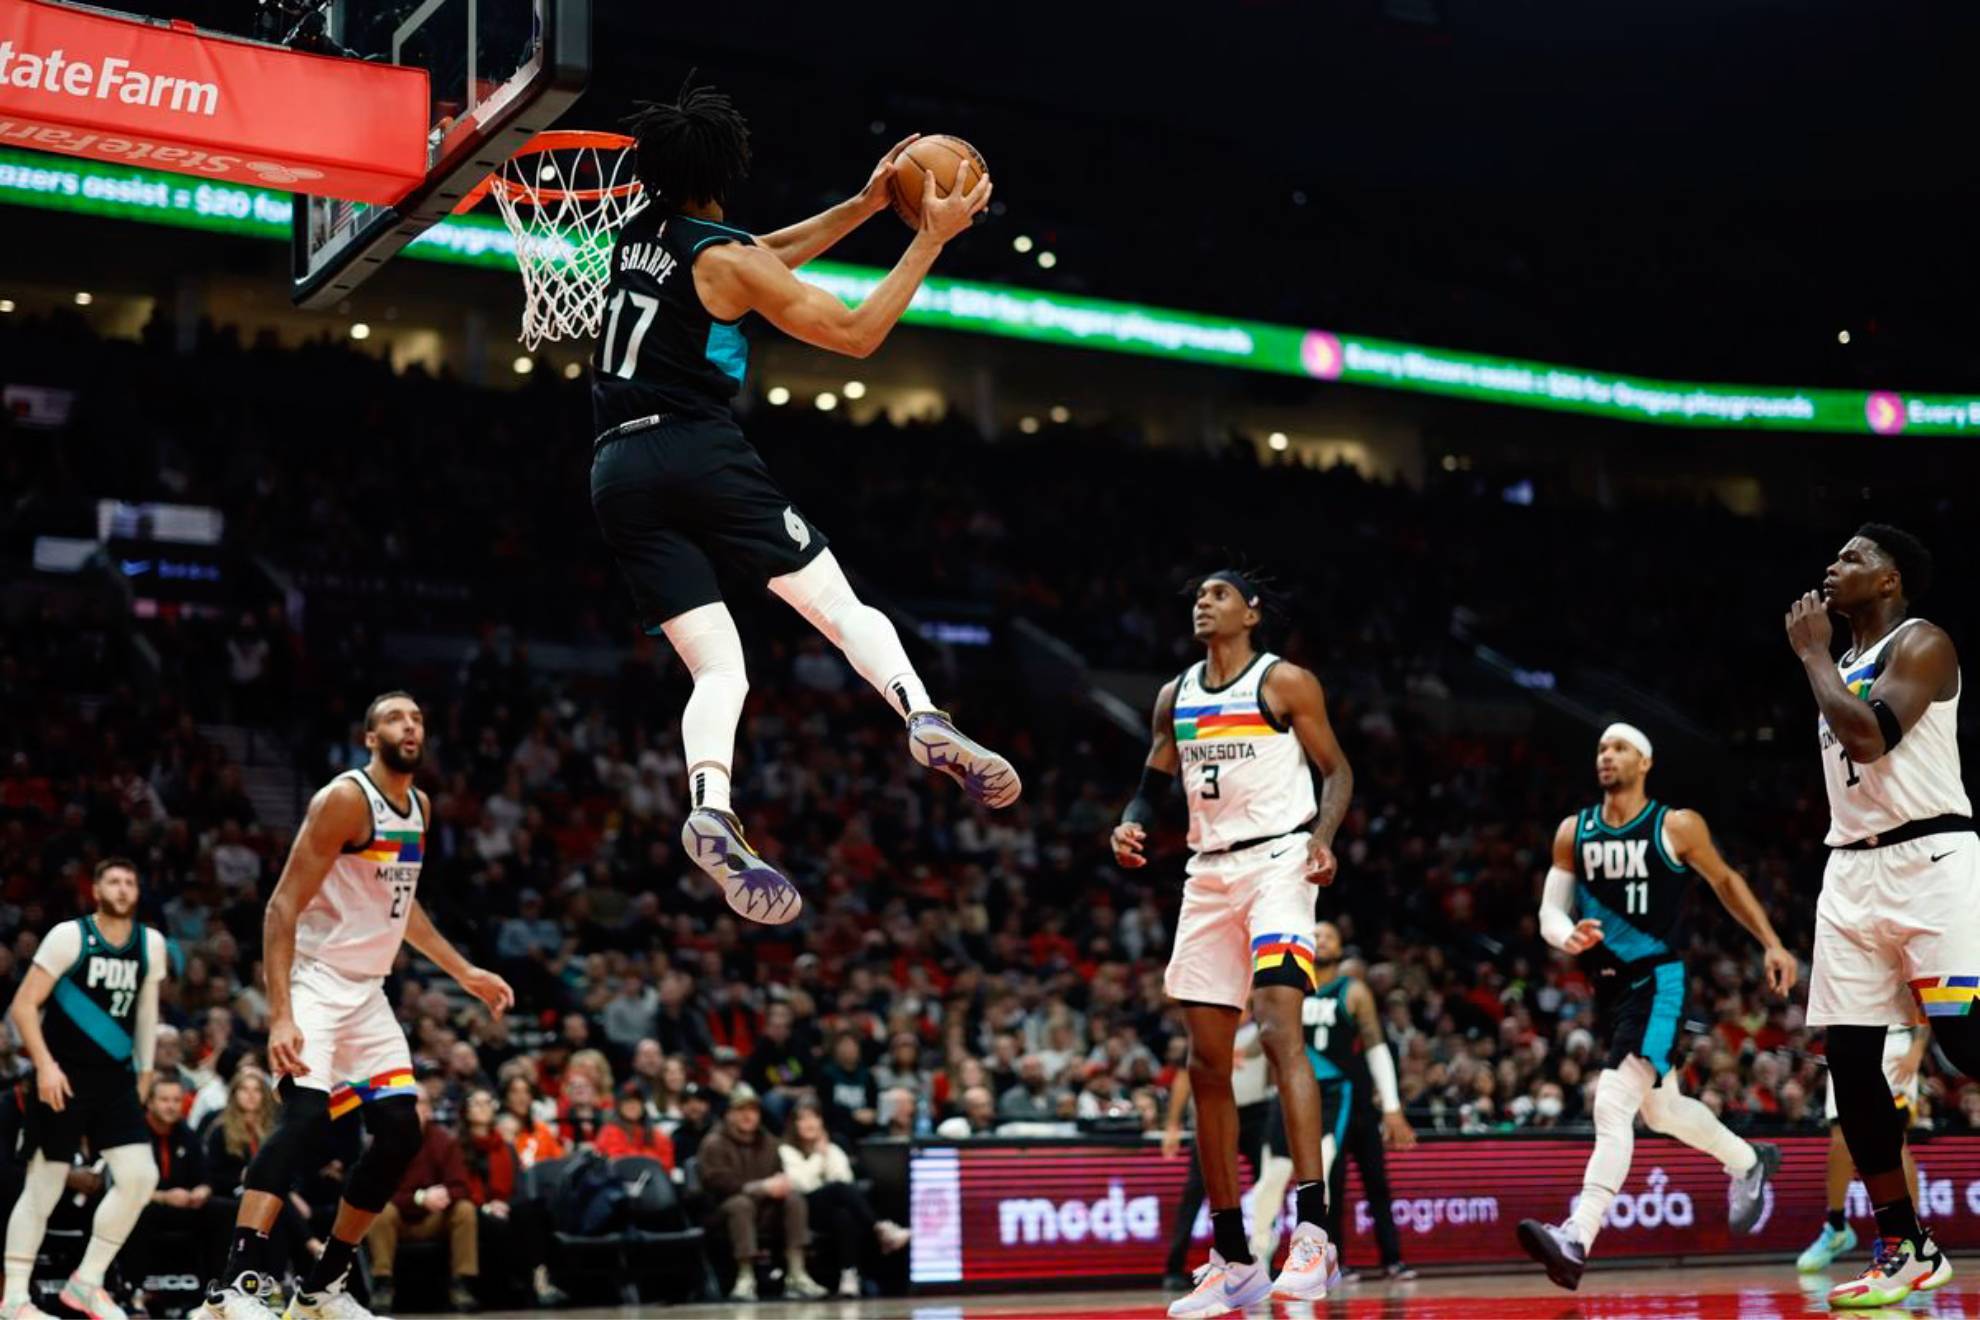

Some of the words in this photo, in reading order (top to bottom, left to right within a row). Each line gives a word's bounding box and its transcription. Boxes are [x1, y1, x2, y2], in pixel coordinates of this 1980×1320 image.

[620, 242, 677, 285] SHARPE
[602, 288, 660, 380] 17
[1182, 742, 1257, 762] INNESOTA
[1840, 750, 1860, 788] 1
[1201, 764, 1220, 800] 3
[1583, 839, 1649, 882] PDX
[390, 886, 411, 919] 27
[1625, 881, 1648, 915] 11
[86, 955, 139, 991] PDX
[109, 990, 135, 1018] 27
[999, 1180, 1159, 1245] moda
[1354, 1197, 1499, 1234] pogram
